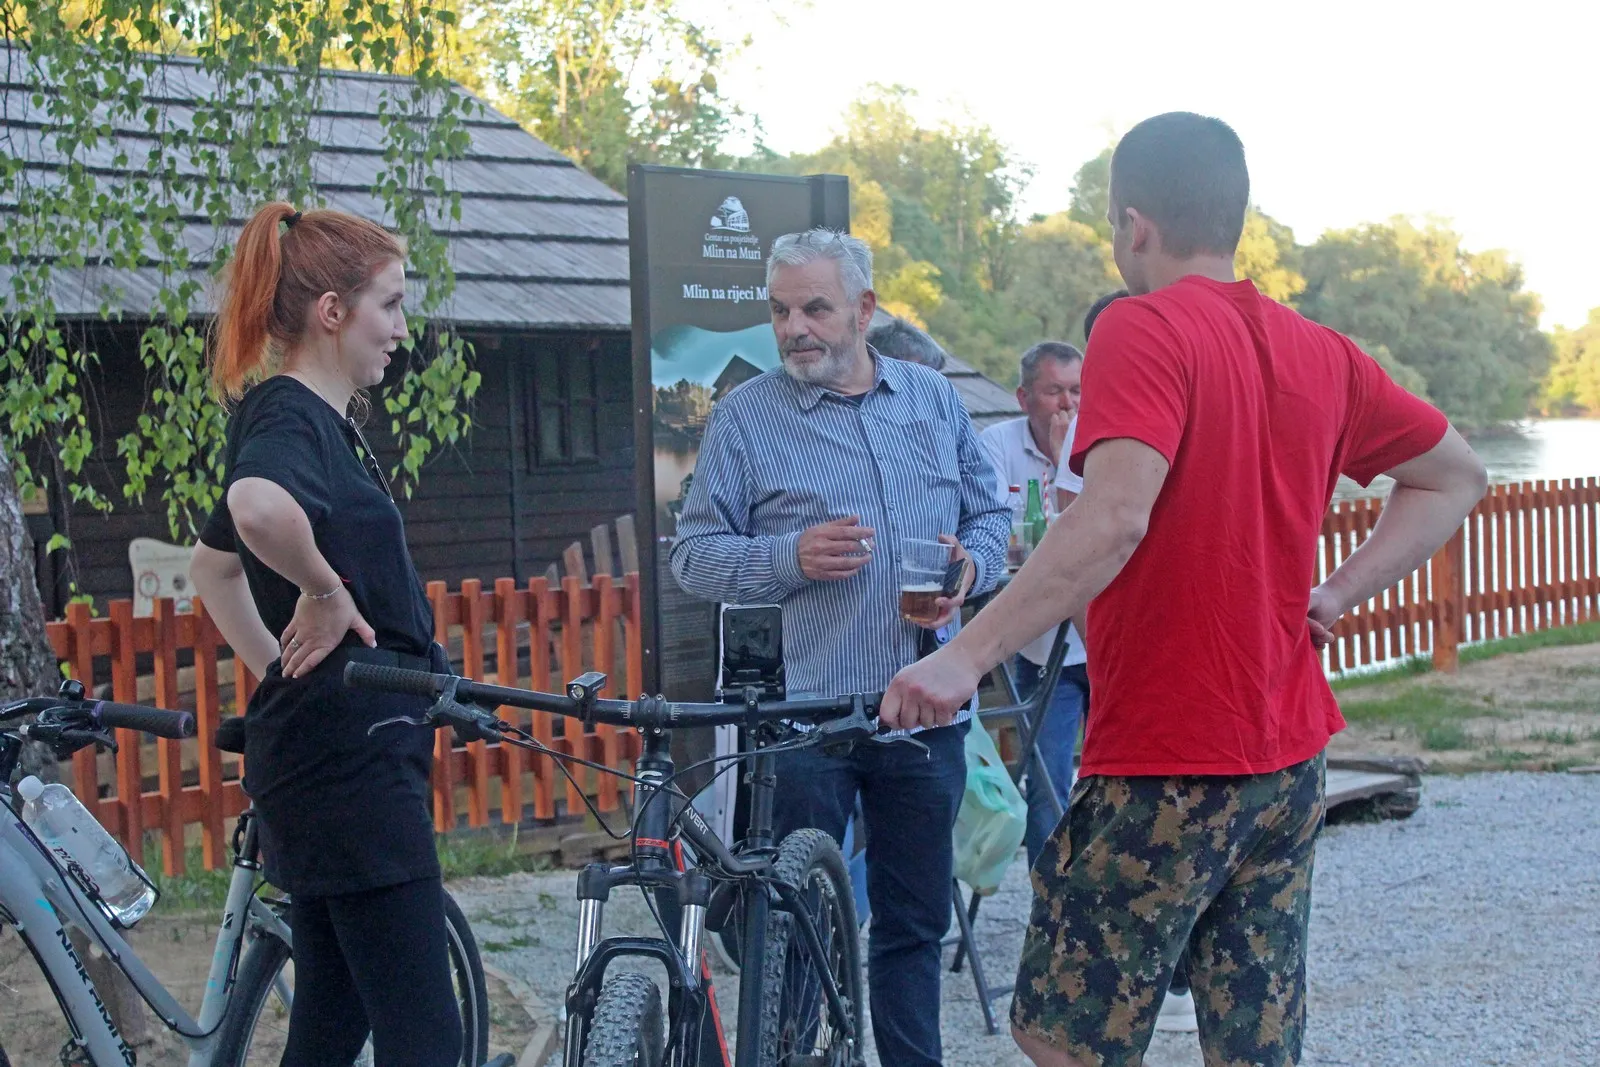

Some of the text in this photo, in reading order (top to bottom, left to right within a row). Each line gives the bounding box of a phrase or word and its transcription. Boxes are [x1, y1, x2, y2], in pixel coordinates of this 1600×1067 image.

[703, 244, 761, 260] Mlin na Muri
[683, 284, 769, 303] Mlin na rijeci M
